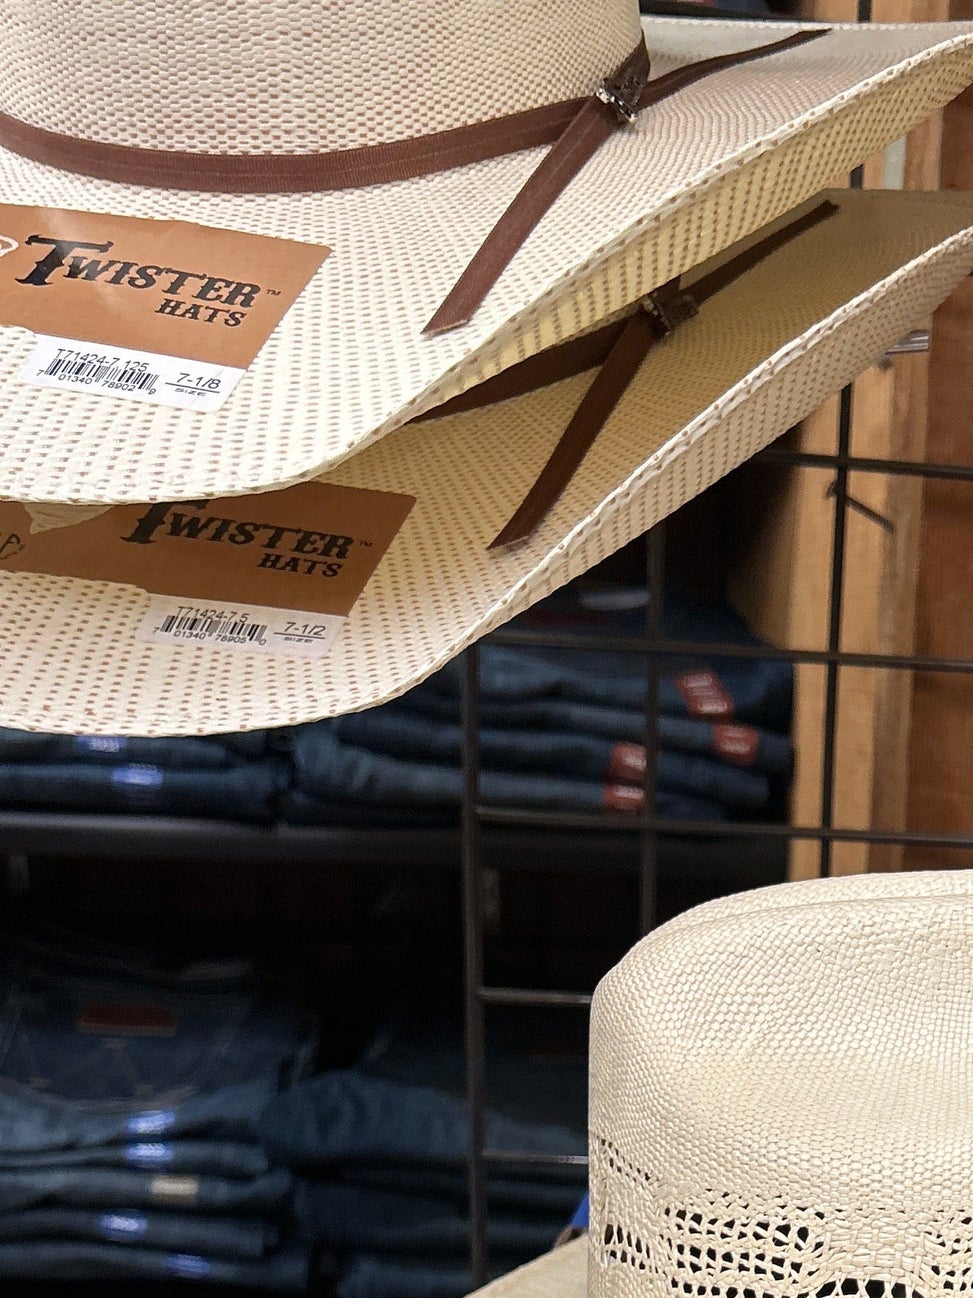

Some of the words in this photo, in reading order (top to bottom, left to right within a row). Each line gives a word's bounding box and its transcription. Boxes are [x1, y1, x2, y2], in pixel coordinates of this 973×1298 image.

[15, 235, 261, 308] TWISTER
[155, 298, 247, 327] HATS
[58, 373, 93, 385] 01340
[101, 380, 137, 392] 78902
[176, 372, 221, 389] 7-1/8
[256, 553, 344, 578] HATS
[173, 630, 207, 640] 01340
[214, 634, 247, 644] 78905
[284, 621, 326, 636] 7-1/2
